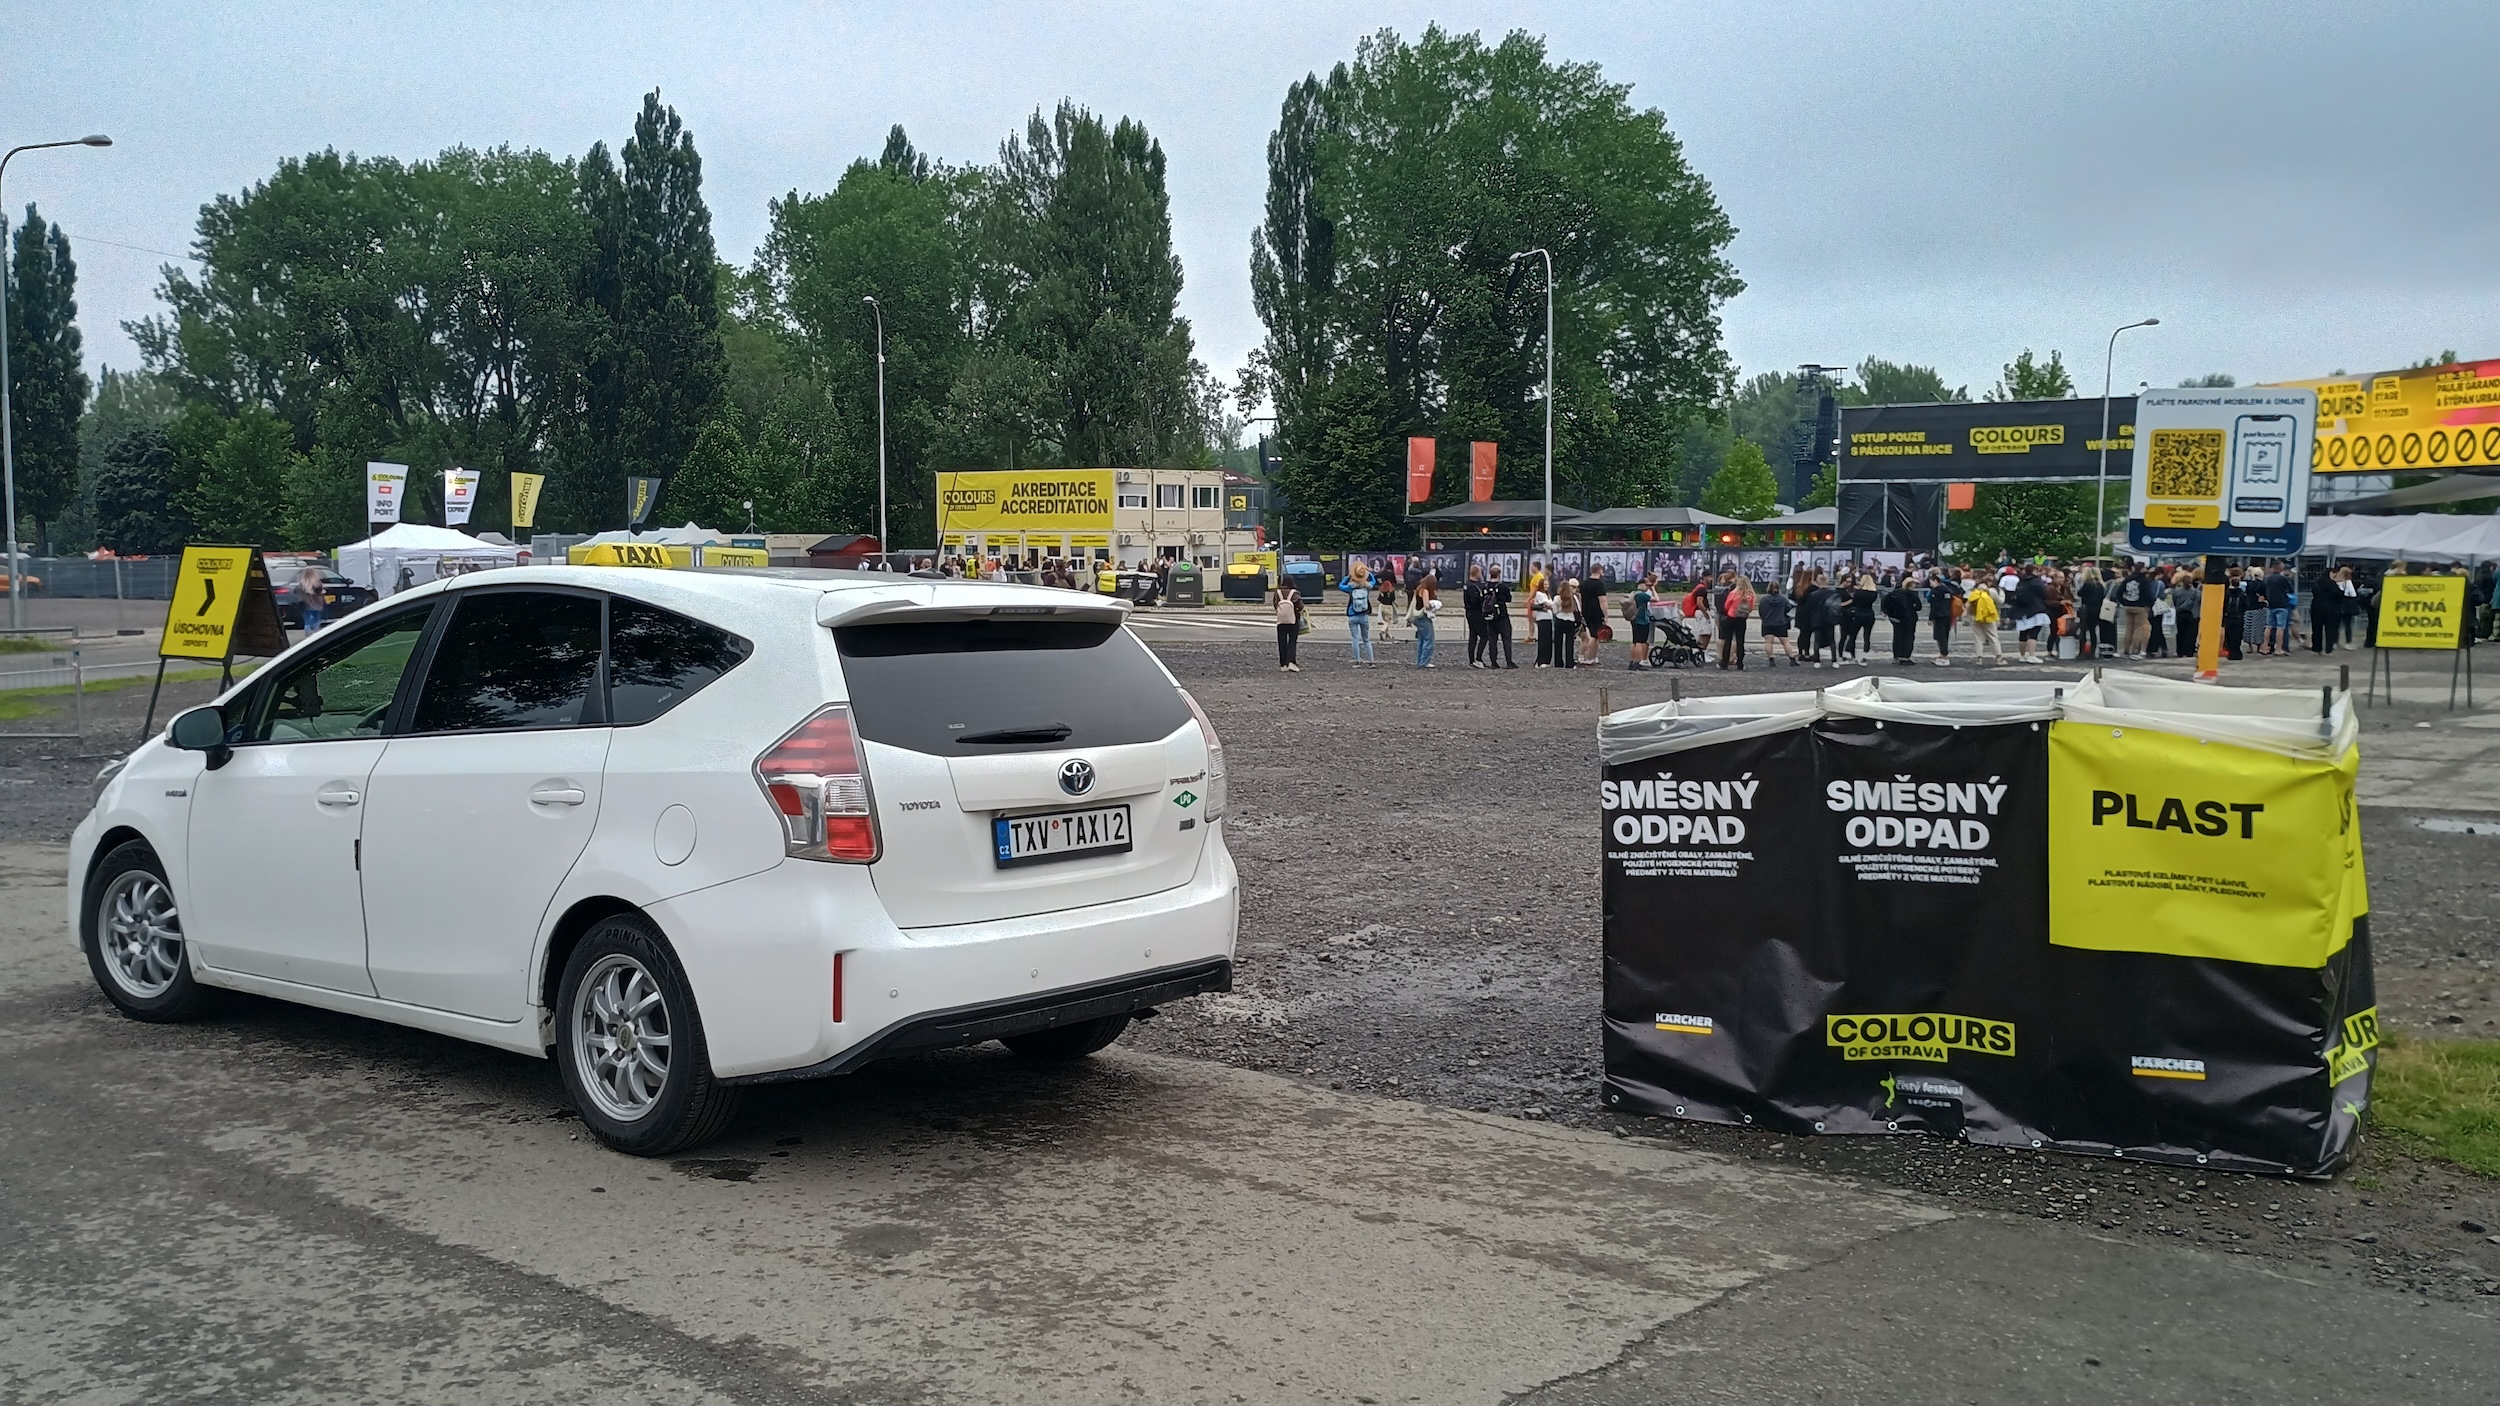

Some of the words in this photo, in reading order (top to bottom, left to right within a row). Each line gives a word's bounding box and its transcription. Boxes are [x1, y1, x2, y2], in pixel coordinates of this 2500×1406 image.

[2177, 396, 2222, 406] PARKOVNÉ
[2273, 397, 2305, 406] ONLINE
[1850, 432, 1887, 443] VSTUP
[1888, 431, 1926, 442] POUZE
[1972, 427, 2062, 444] COLOURS
[1850, 446, 1859, 456] S
[1859, 443, 1903, 456] PÁSKOU
[1904, 445, 1921, 455] NA
[1921, 443, 1953, 455] RUCE
[944, 490, 995, 504] COLOURS
[1011, 481, 1096, 498] AKREDITACE
[1000, 498, 1108, 515] ACCREDITATION
[612, 545, 664, 565] TAXI
[2394, 598, 2447, 613] PITNÁ
[173, 619, 224, 636] ÚSCHOVNA
[2395, 616, 2444, 628] VODA
[1600, 771, 1760, 810] SMĚSNÝ
[1826, 773, 2008, 816] SMĚSNÝ
[899, 800, 941, 811] TOYOTA
[2092, 789, 2265, 840] PLAST
[1010, 819, 1049, 853] TXV
[1612, 814, 1746, 845] ODPAD
[1845, 815, 1991, 851] ODPAD
[999, 845, 1010, 855] CZ
[2196, 875, 2214, 885] PET
[1831, 1016, 2012, 1051] COLOURS
[1847, 1046, 1870, 1058] OF
[1870, 1045, 1945, 1060] OSTRAVA
[1922, 1080, 1964, 1097] festival
